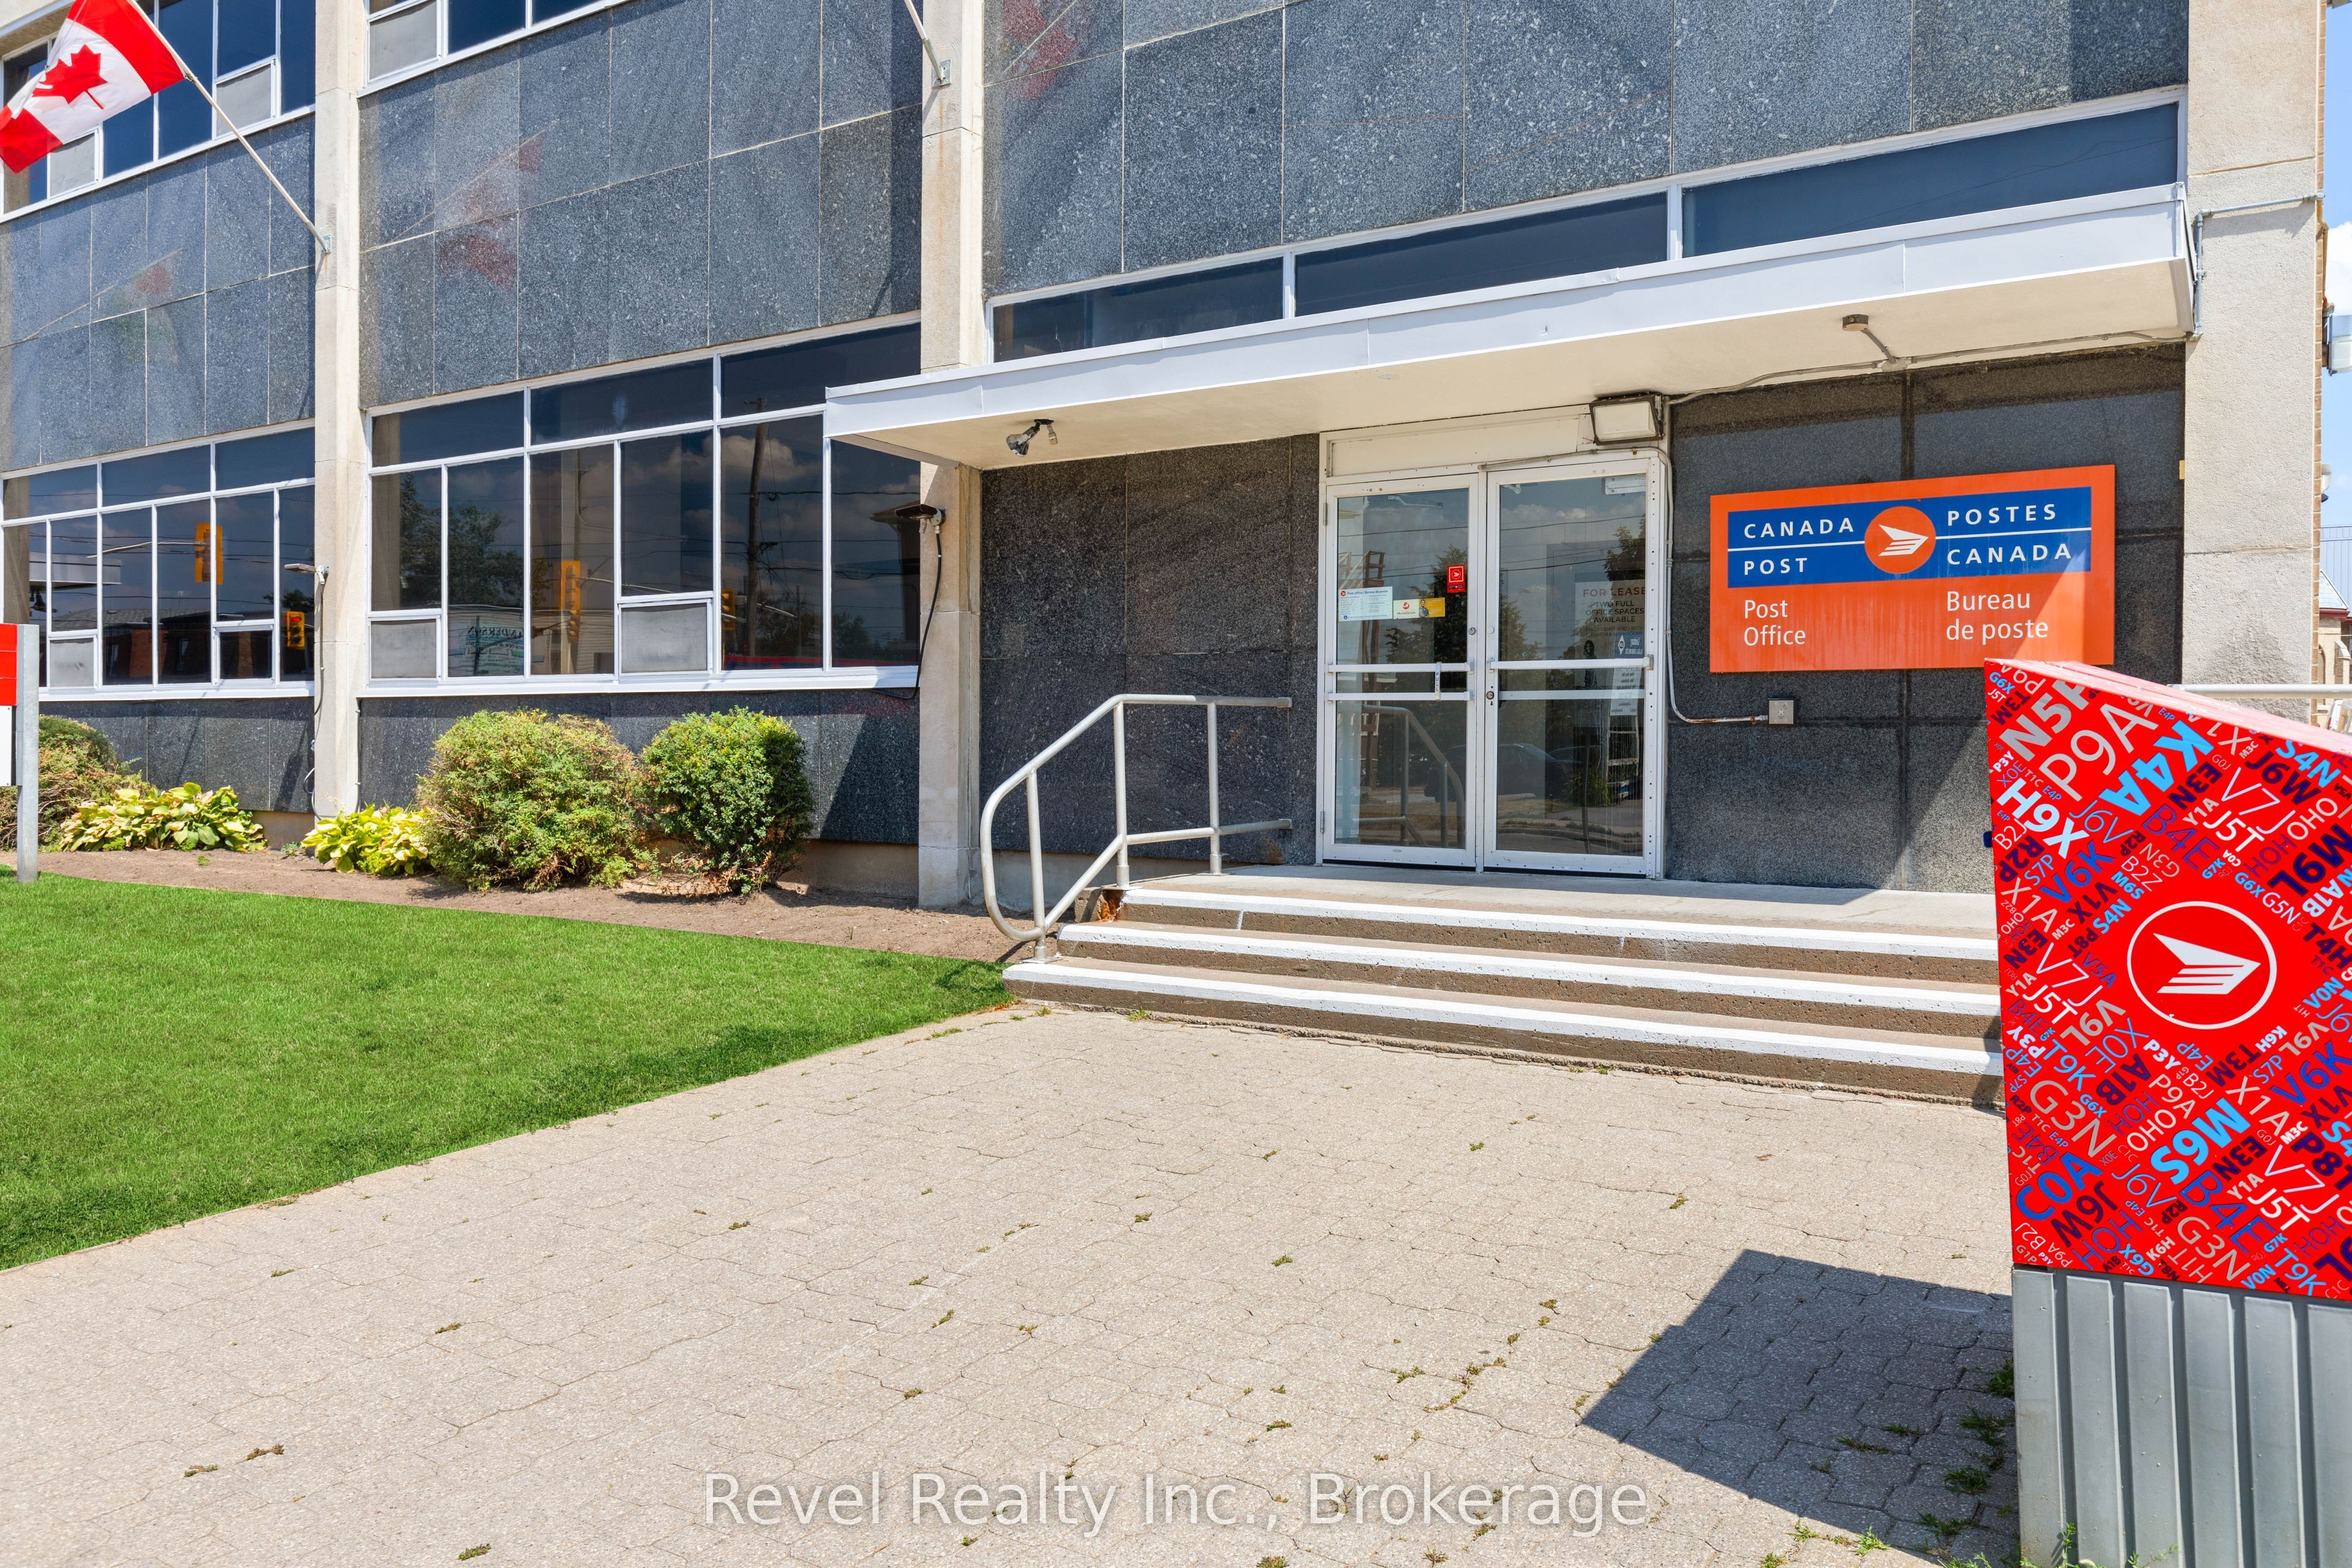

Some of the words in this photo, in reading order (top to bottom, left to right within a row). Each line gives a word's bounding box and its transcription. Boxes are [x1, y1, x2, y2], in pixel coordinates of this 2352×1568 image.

[1744, 518, 1854, 538] CANADA
[1948, 503, 2056, 526] POSTES
[1744, 557, 1807, 575] POST
[1947, 543, 2071, 565] CANADA
[1583, 589, 1606, 597] FOR
[1611, 587, 1645, 596] LEASE
[1947, 590, 2030, 611] Bureau
[1744, 600, 1788, 619] Post
[1744, 625, 1806, 646] Office
[1947, 619, 1974, 640] de
[1982, 619, 2048, 645] poste
[1988, 688, 2007, 703] J5T
[1989, 671, 2015, 695] G6X
[1991, 690, 2031, 725] T3M
[2158, 707, 2175, 721] E4P
[1992, 750, 2014, 772] P3Y
[2038, 703, 2159, 802] P9A
[2239, 741, 2260, 759] M3C
[2275, 740, 2342, 788] S4N
[2098, 720, 2215, 816] K4A
[2244, 751, 2321, 805] J6W
[2042, 785, 2062, 801] E4P
[2167, 761, 2223, 810] E3N
[2221, 767, 2296, 834] V7J
[1997, 778, 2090, 859] H9X
[2068, 799, 2134, 843] J6V
[2182, 797, 2220, 826] Y1A
[1994, 818, 2027, 850] B2J
[2119, 830, 2147, 857] R2P
[2143, 803, 2220, 871] B4E
[2203, 810, 2265, 853] J5T
[1999, 835, 2045, 882] R2P
[2024, 854, 2054, 886] S7P
[2038, 839, 2116, 903] V6K
[2120, 855, 2163, 892] B2Z
[2202, 858, 2226, 879] G7K
[2111, 871, 2144, 900] M6S
[2234, 872, 2266, 899] G6X
[2302, 879, 2344, 917] A1B
[2000, 876, 2057, 933] X1A
[2066, 881, 2119, 924] V1X
[2092, 898, 2132, 934] S4N
[2263, 892, 2301, 924] G5N
[2051, 919, 2075, 940] M3C
[2068, 927, 2099, 959] P8T
[2003, 928, 2049, 970] E3N
[2302, 922, 2352, 970] T4H
[2005, 972, 2037, 997] Y1A
[2036, 942, 2103, 1006] V7J
[2082, 951, 2117, 988] V5A
[2009, 999, 2048, 1035] B4E
[2022, 984, 2078, 1025] J5T
[2006, 1025, 2046, 1059] P3Y
[2040, 1027, 2056, 1041] G7K
[2255, 1025, 2288, 1053] K6H
[2005, 1048, 2042, 1078] E4P
[2043, 1038, 2096, 1091] T9K
[2143, 1039, 2182, 1070] P3Y
[2176, 1042, 2214, 1071] E4P
[2206, 1044, 2261, 1088] T3M
[2253, 1054, 2283, 1084] S7P
[2096, 1053, 2151, 1106] A1B
[2183, 1072, 2214, 1099] B2J
[2269, 1041, 2352, 1105] V6K
[2079, 1093, 2107, 1118] G6X
[2148, 1073, 2196, 1120] P9A
[2225, 1076, 2290, 1137] X1A
[2030, 1080, 2117, 1158] G3N
[2031, 1114, 2051, 1133] T1C
[2280, 1121, 2308, 1145] M3C
[2012, 1122, 2059, 1164] B4E
[2049, 1131, 2068, 1147] E4P
[2211, 1135, 2268, 1182] E3N
[2111, 1163, 2177, 1207] J6V
[2226, 1173, 2264, 1200] Y1A
[2264, 1144, 2340, 1214] V7J
[2125, 1200, 2146, 1216] E4P
[2162, 1200, 2188, 1224] R2P
[2179, 1170, 2277, 1255] B4E
[2247, 1188, 2310, 1231] J5T
[2015, 1222, 2046, 1250] B2J
[2146, 1236, 2176, 1261] K6H
[2177, 1216, 2251, 1281] G3N
[2264, 1232, 2288, 1253] G7K
[2016, 1245, 2037, 1263] G1P
[2038, 1252, 2053, 1265] P3Y
[2102, 1256, 2123, 1273] A1B
[2118, 1243, 2154, 1276] G6X
[2274, 1247, 2327, 1296] T9K
